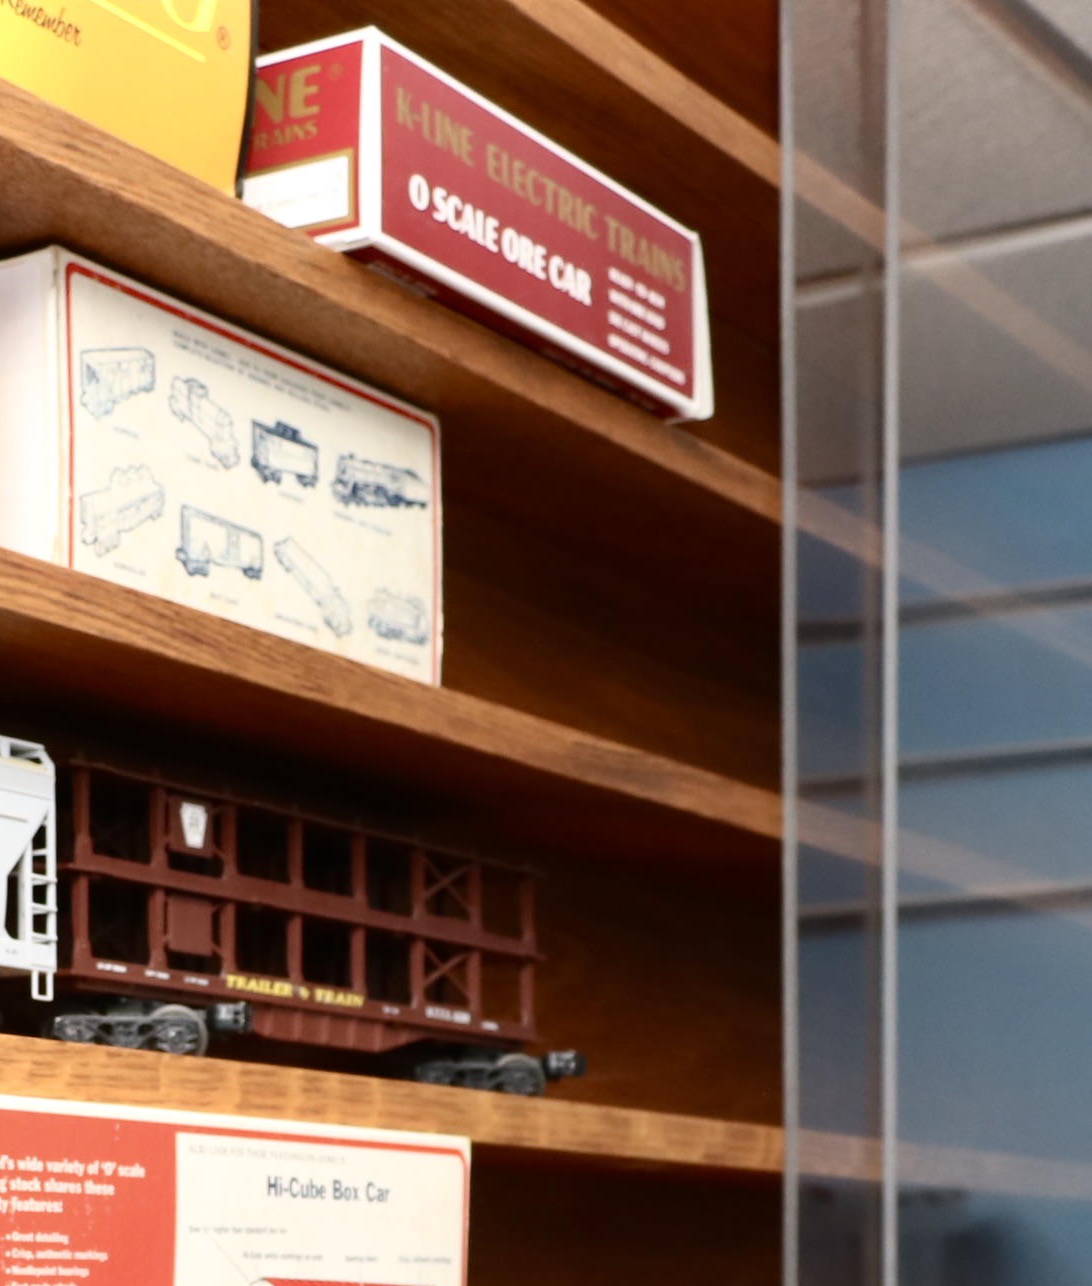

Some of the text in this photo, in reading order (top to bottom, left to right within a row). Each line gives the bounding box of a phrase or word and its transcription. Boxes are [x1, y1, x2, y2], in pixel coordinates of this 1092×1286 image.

[395, 86, 476, 168] K-LINE
[486, 142, 599, 241] ELECTRIC
[605, 215, 686, 292] TRAINS
[431, 189, 499, 253] SCALE
[500, 226, 547, 280] ORE
[548, 255, 593, 306] CAR
[226, 974, 294, 998] TRAILER
[312, 986, 366, 1009] TRAIN
[17, 1155, 44, 1173] wide
[46, 1158, 86, 1178] variety
[86, 1160, 101, 1176] of
[117, 1163, 147, 1179] scale
[9, 1176, 42, 1193] stock
[44, 1177, 84, 1195] shares
[84, 1179, 116, 1197] these
[267, 1176, 392, 1203] Hi-Cube Box Car
